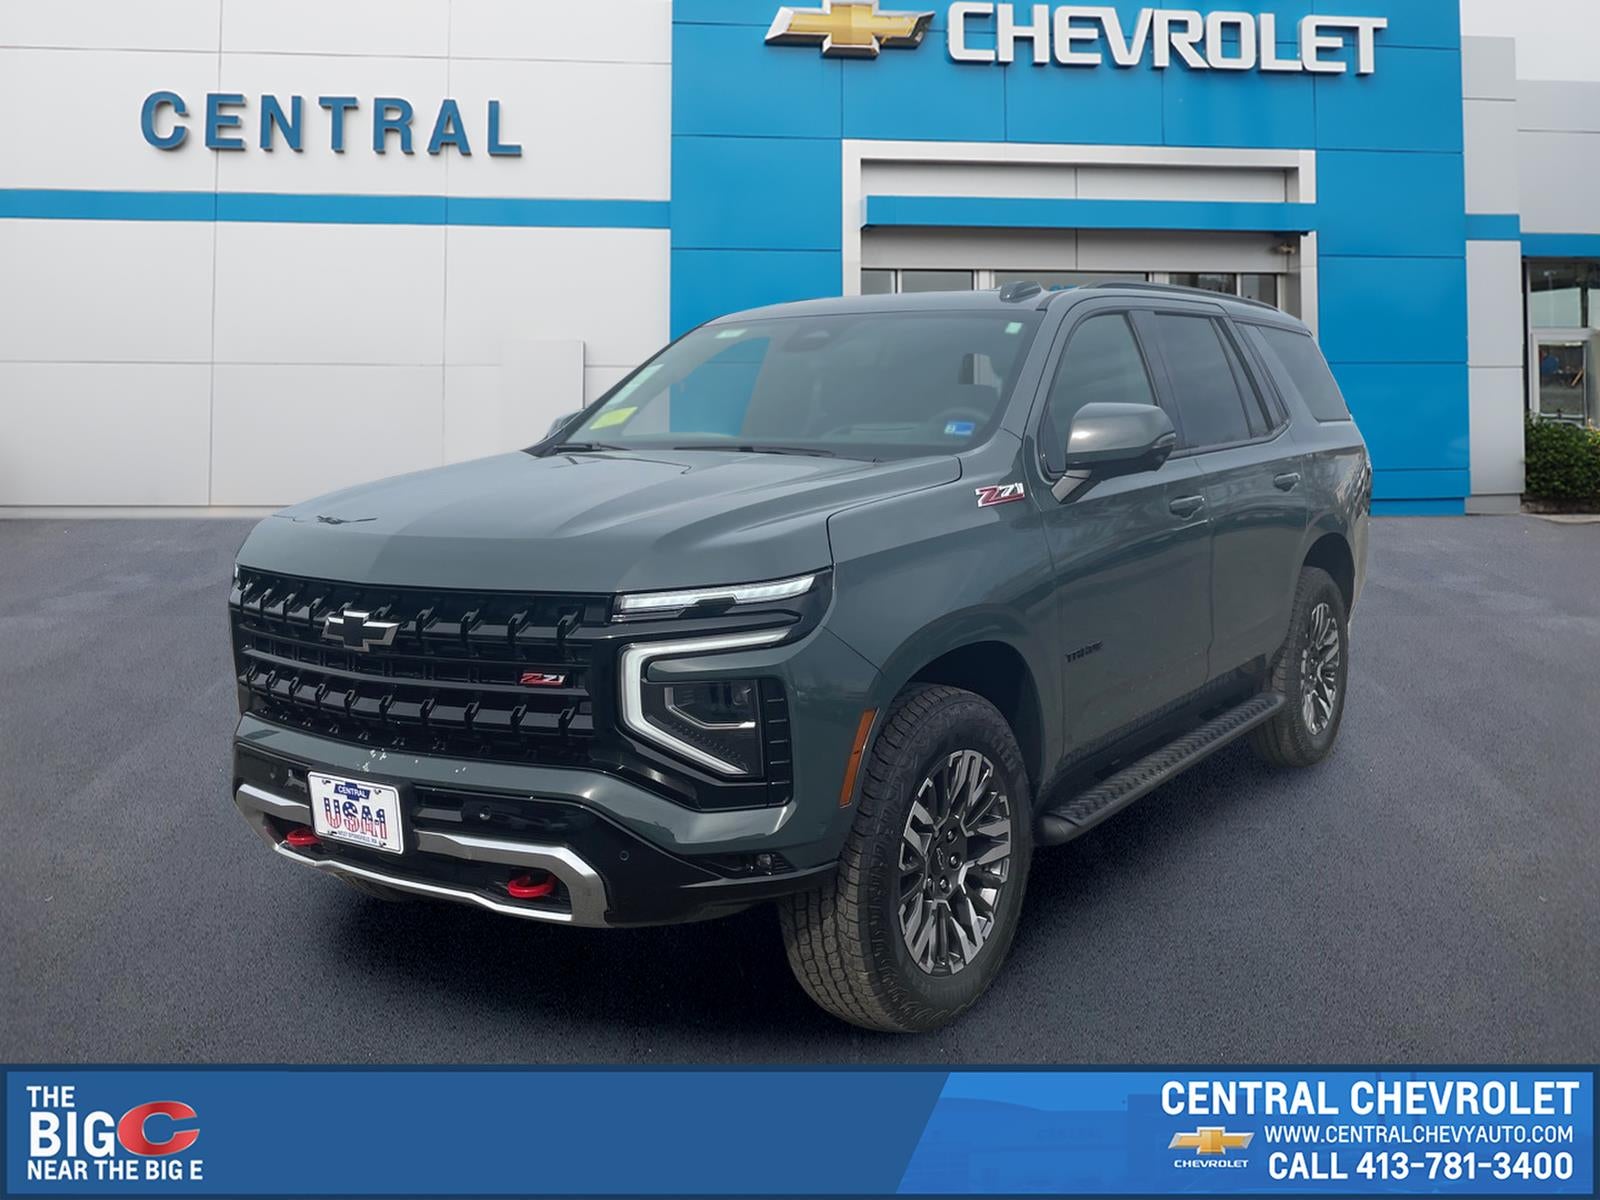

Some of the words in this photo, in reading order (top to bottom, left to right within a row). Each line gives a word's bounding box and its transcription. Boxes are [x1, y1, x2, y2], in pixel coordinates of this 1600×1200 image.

[947, 1, 1388, 75] CHEVROLET
[140, 90, 523, 158] CENTRAL
[975, 482, 1025, 508] Z71
[520, 672, 566, 686] Z71
[337, 785, 368, 798] CENTRAL
